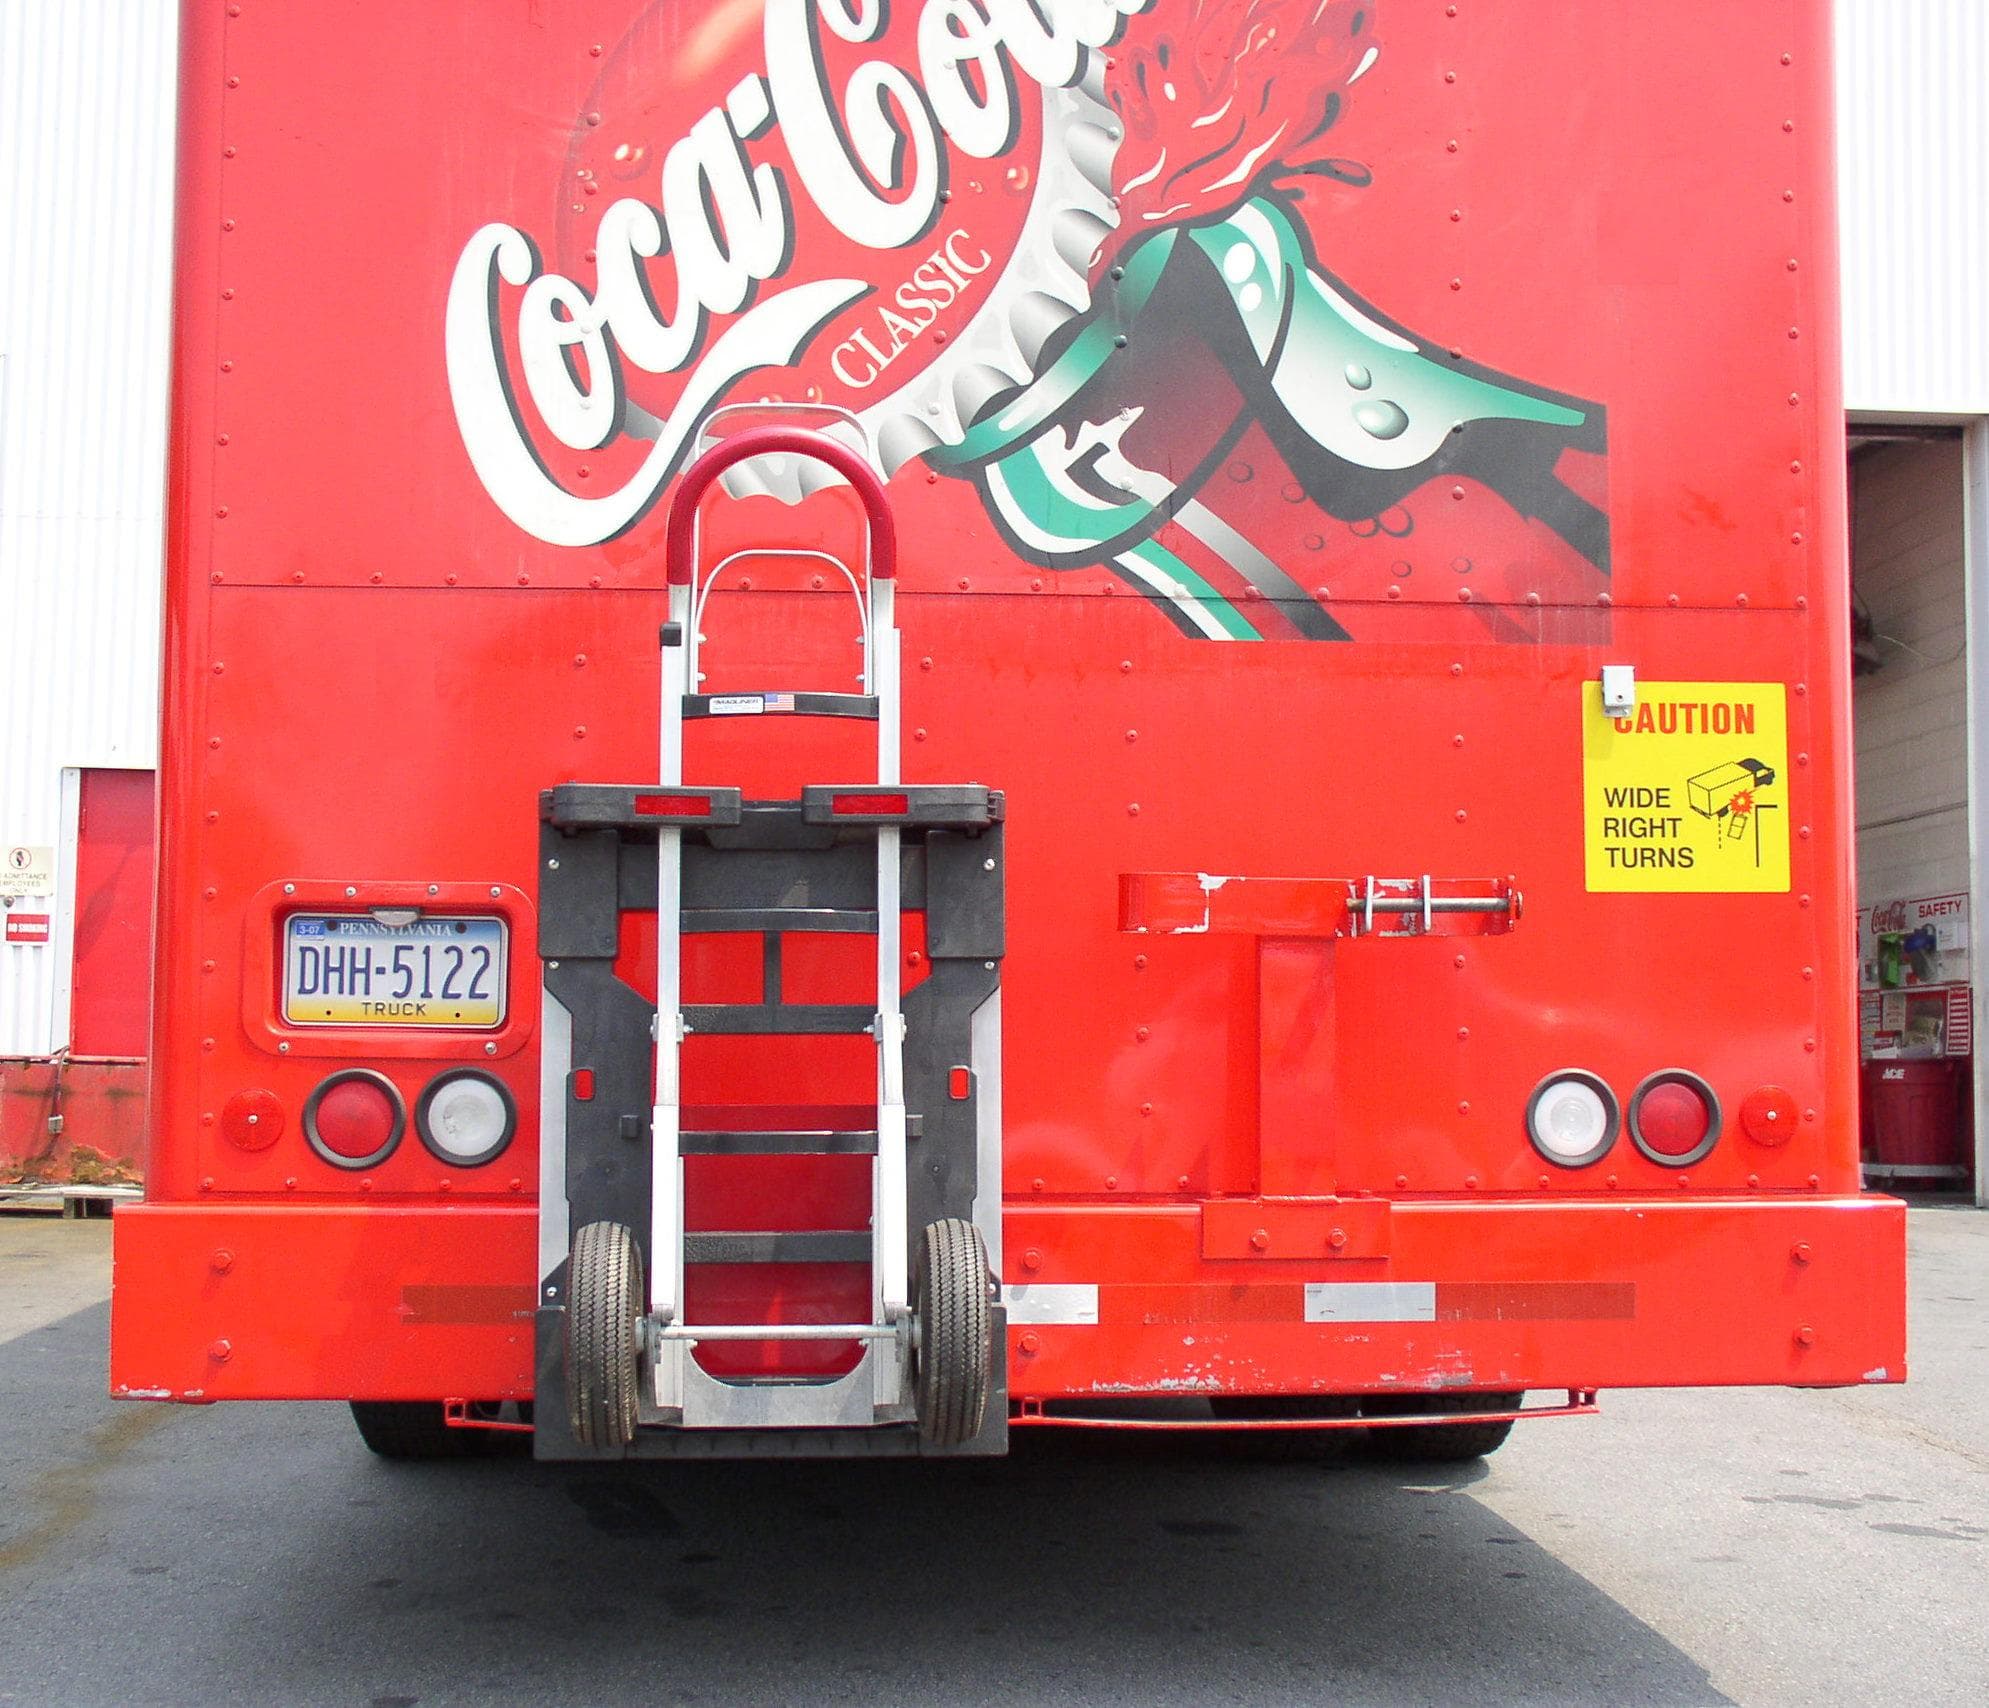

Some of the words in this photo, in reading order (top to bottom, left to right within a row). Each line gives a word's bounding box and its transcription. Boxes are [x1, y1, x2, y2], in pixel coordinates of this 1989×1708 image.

[445, 0, 1155, 547] Coca-Co
[831, 228, 992, 389] CLASSIC
[1603, 787, 1671, 808] WIDE
[1603, 817, 1682, 838] RIGHT
[1604, 847, 1695, 869] TURNS
[1918, 900, 1962, 918] SAFETY
[299, 925, 320, 935] 3-07
[298, 944, 491, 1000] DHH-5122
[362, 1001, 427, 1016] TRUCK
[1882, 1067, 1905, 1080] ACE
